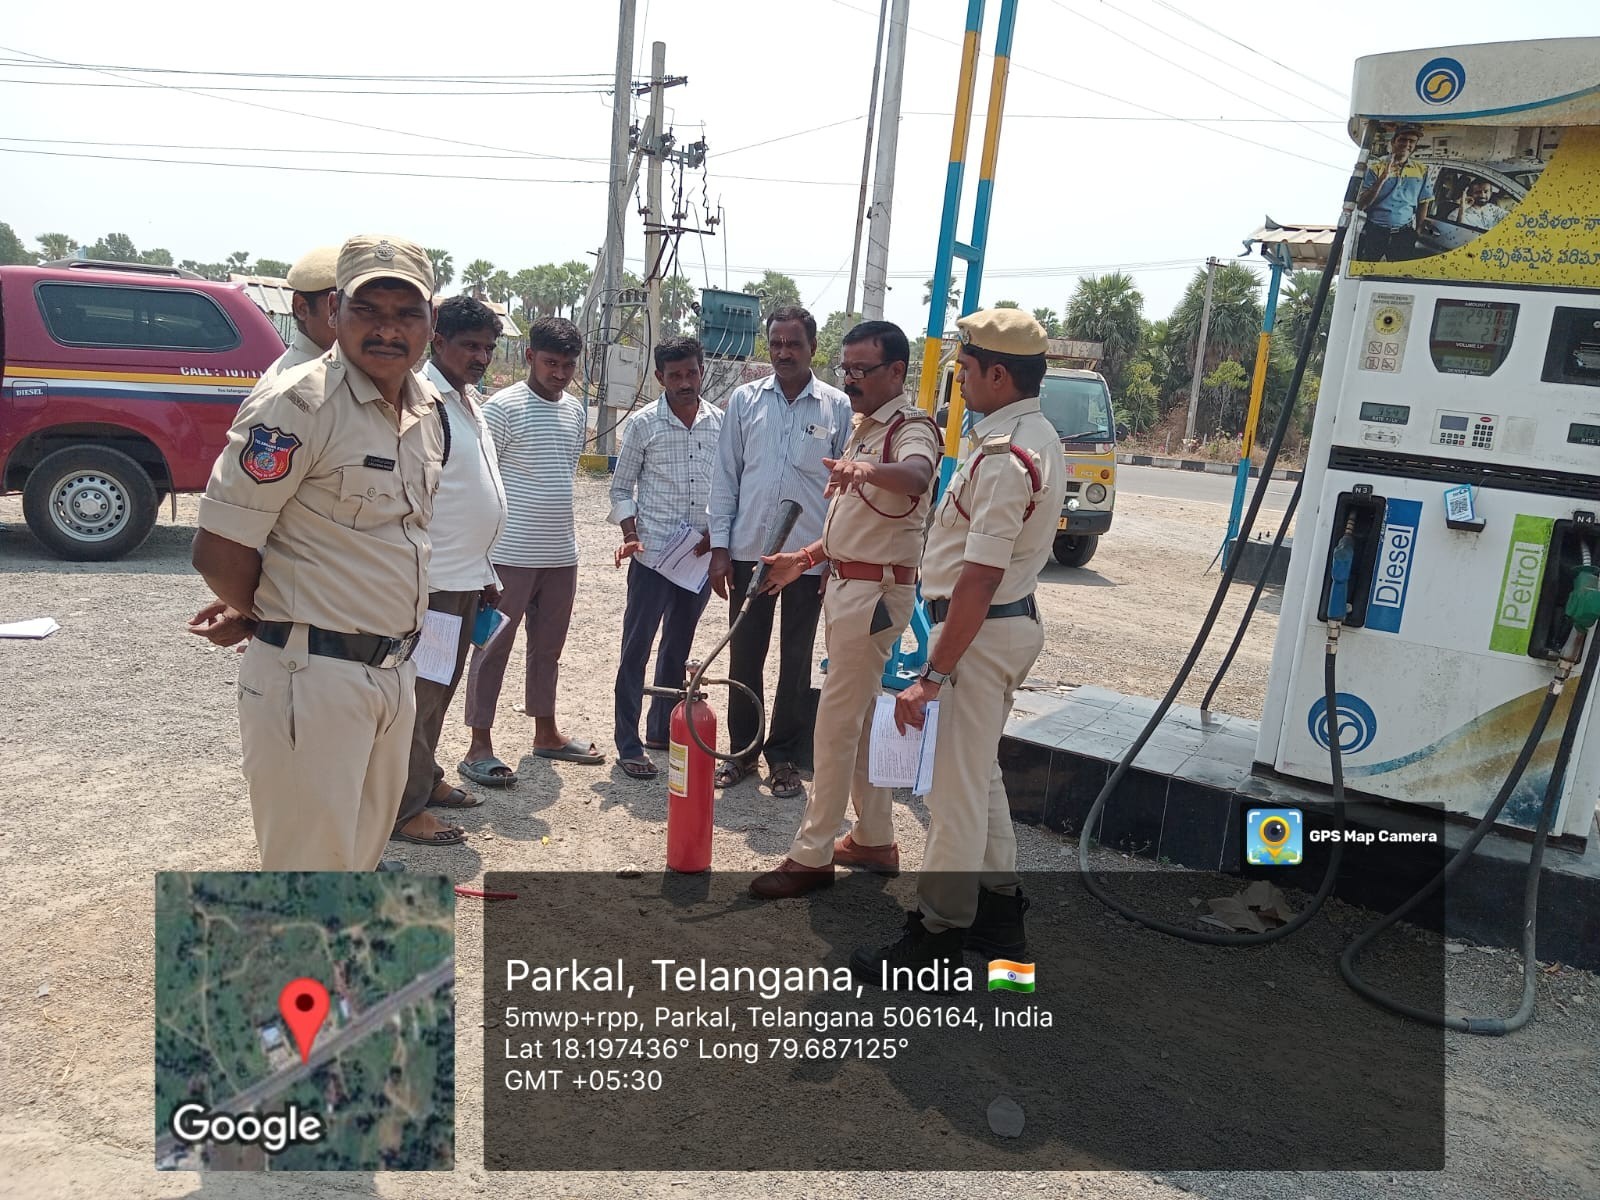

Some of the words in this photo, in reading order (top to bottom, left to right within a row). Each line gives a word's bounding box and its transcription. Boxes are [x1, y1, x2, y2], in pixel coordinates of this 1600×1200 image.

[16, 388, 43, 396] DIESEL
[180, 367, 212, 376] CALL
[1375, 527, 1411, 604] Diesel
[1502, 547, 1540, 622] Petrol
